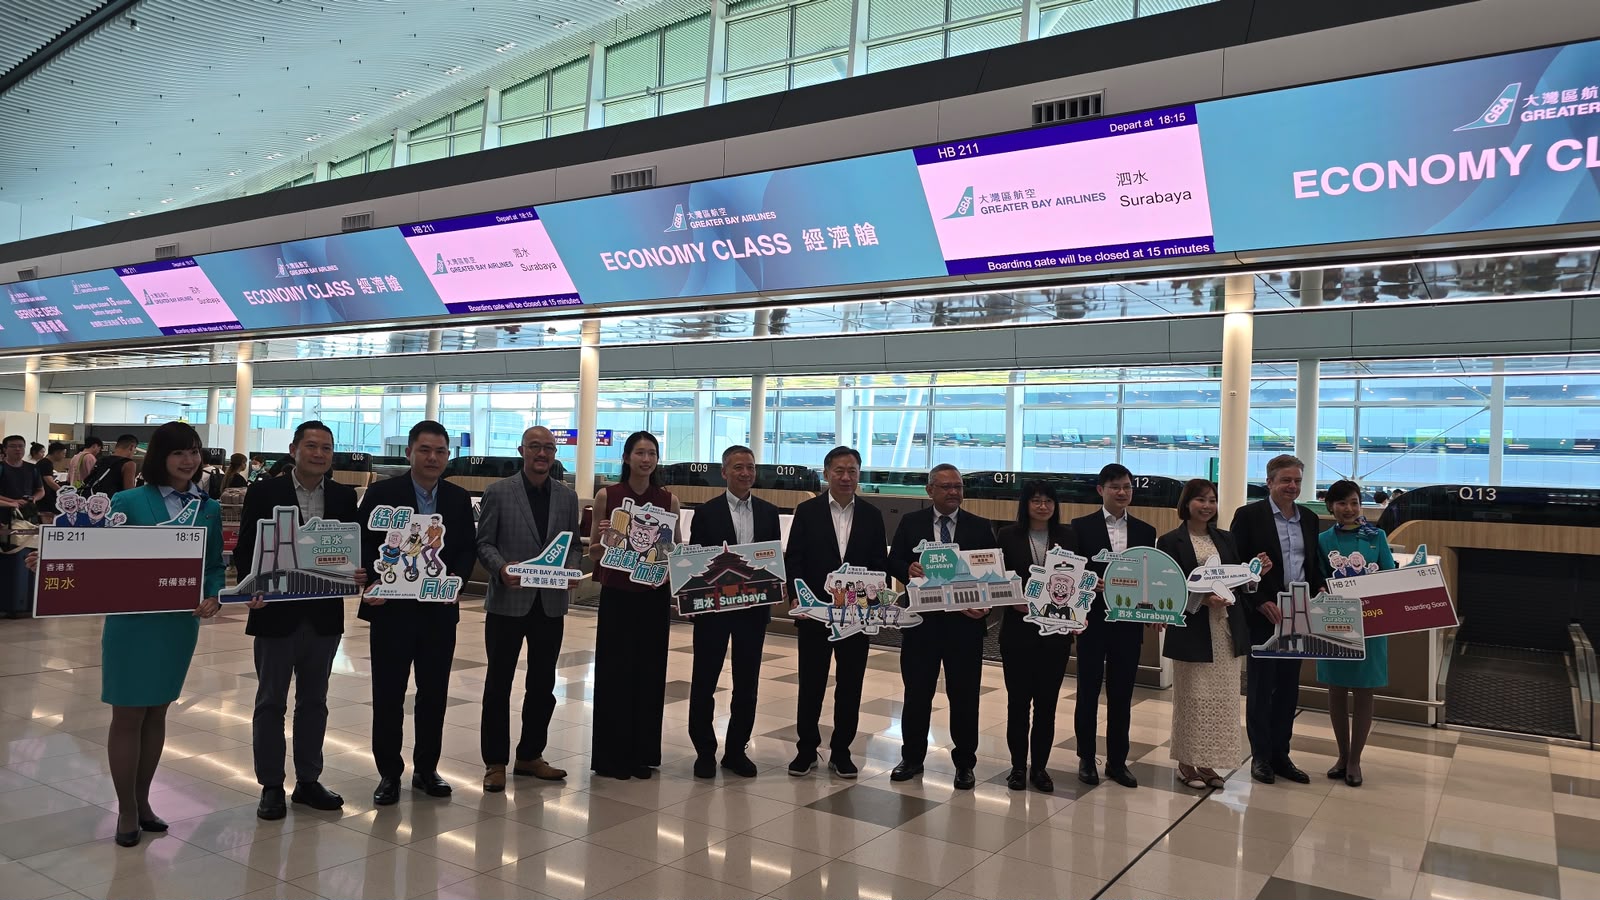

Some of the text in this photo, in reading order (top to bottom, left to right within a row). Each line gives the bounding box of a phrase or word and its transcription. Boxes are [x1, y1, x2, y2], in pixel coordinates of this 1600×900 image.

[1522, 86, 1599, 108] 大灣區航
[1484, 97, 1513, 123] GBA
[1520, 103, 1600, 122] GREATER
[1110, 112, 1186, 133] Depart at 18:15
[937, 143, 980, 159] HB 211
[1293, 136, 1600, 199] ECONOMY CL
[1116, 170, 1149, 187] 泗水
[978, 188, 1036, 204] 大灣區航空
[1120, 189, 1192, 208] Surabaya
[957, 196, 972, 216] GBA
[980, 192, 1106, 215] GREATER BAY AIRLINES
[496, 214, 512, 223] Depart
[519, 212, 533, 220] 18:15
[687, 208, 728, 220] 大灣區航空
[690, 211, 777, 230] GREATER BAY AIRLINES
[412, 224, 436, 234] HB 211
[802, 222, 880, 252] 經濟艙
[600, 232, 792, 271] ECONOMY CLASS
[988, 242, 1210, 271] Boarding gate will be closed at 15 minutes
[450, 265, 477, 274] GREATER
[488, 261, 514, 270] AIRLINES
[520, 261, 557, 272] Surabaya
[242, 280, 356, 305] ECONOMY CLASS
[468, 302, 494, 312] Boarding
[514, 301, 522, 309] be
[522, 300, 542, 308] closed
[556, 297, 581, 305] minutes
[352, 453, 364, 461] Q06
[470, 457, 483, 465] Q07
[690, 463, 708, 473] Q09
[776, 466, 795, 476] Q10
[994, 472, 1016, 484] Q11
[1134, 477, 1149, 488] 12
[1459, 487, 1496, 500] Q13
[178, 507, 195, 524] GBA
[372, 508, 411, 529] 結伴
[48, 531, 85, 541] HB 211
[175, 532, 200, 542] 18:15
[313, 546, 351, 554] Surabaya
[545, 544, 566, 564] GBA
[603, 547, 640, 570] 滿載
[929, 553, 947, 563] 泗水
[1415, 552, 1424, 564] GBA
[508, 567, 538, 575] GREATER
[553, 570, 581, 578] AIRLINES
[1417, 568, 1437, 576] 18:15
[44, 577, 75, 590] 泗水
[158, 577, 197, 587] 預備登機
[420, 578, 459, 599] 同行
[693, 592, 767, 610] 泗水 Surabaya
[800, 588, 814, 606] GBA
[1362, 608, 1383, 617] baya
[1404, 602, 1431, 611] Boarding
[1118, 610, 1174, 622] 泗水 Surabaya
